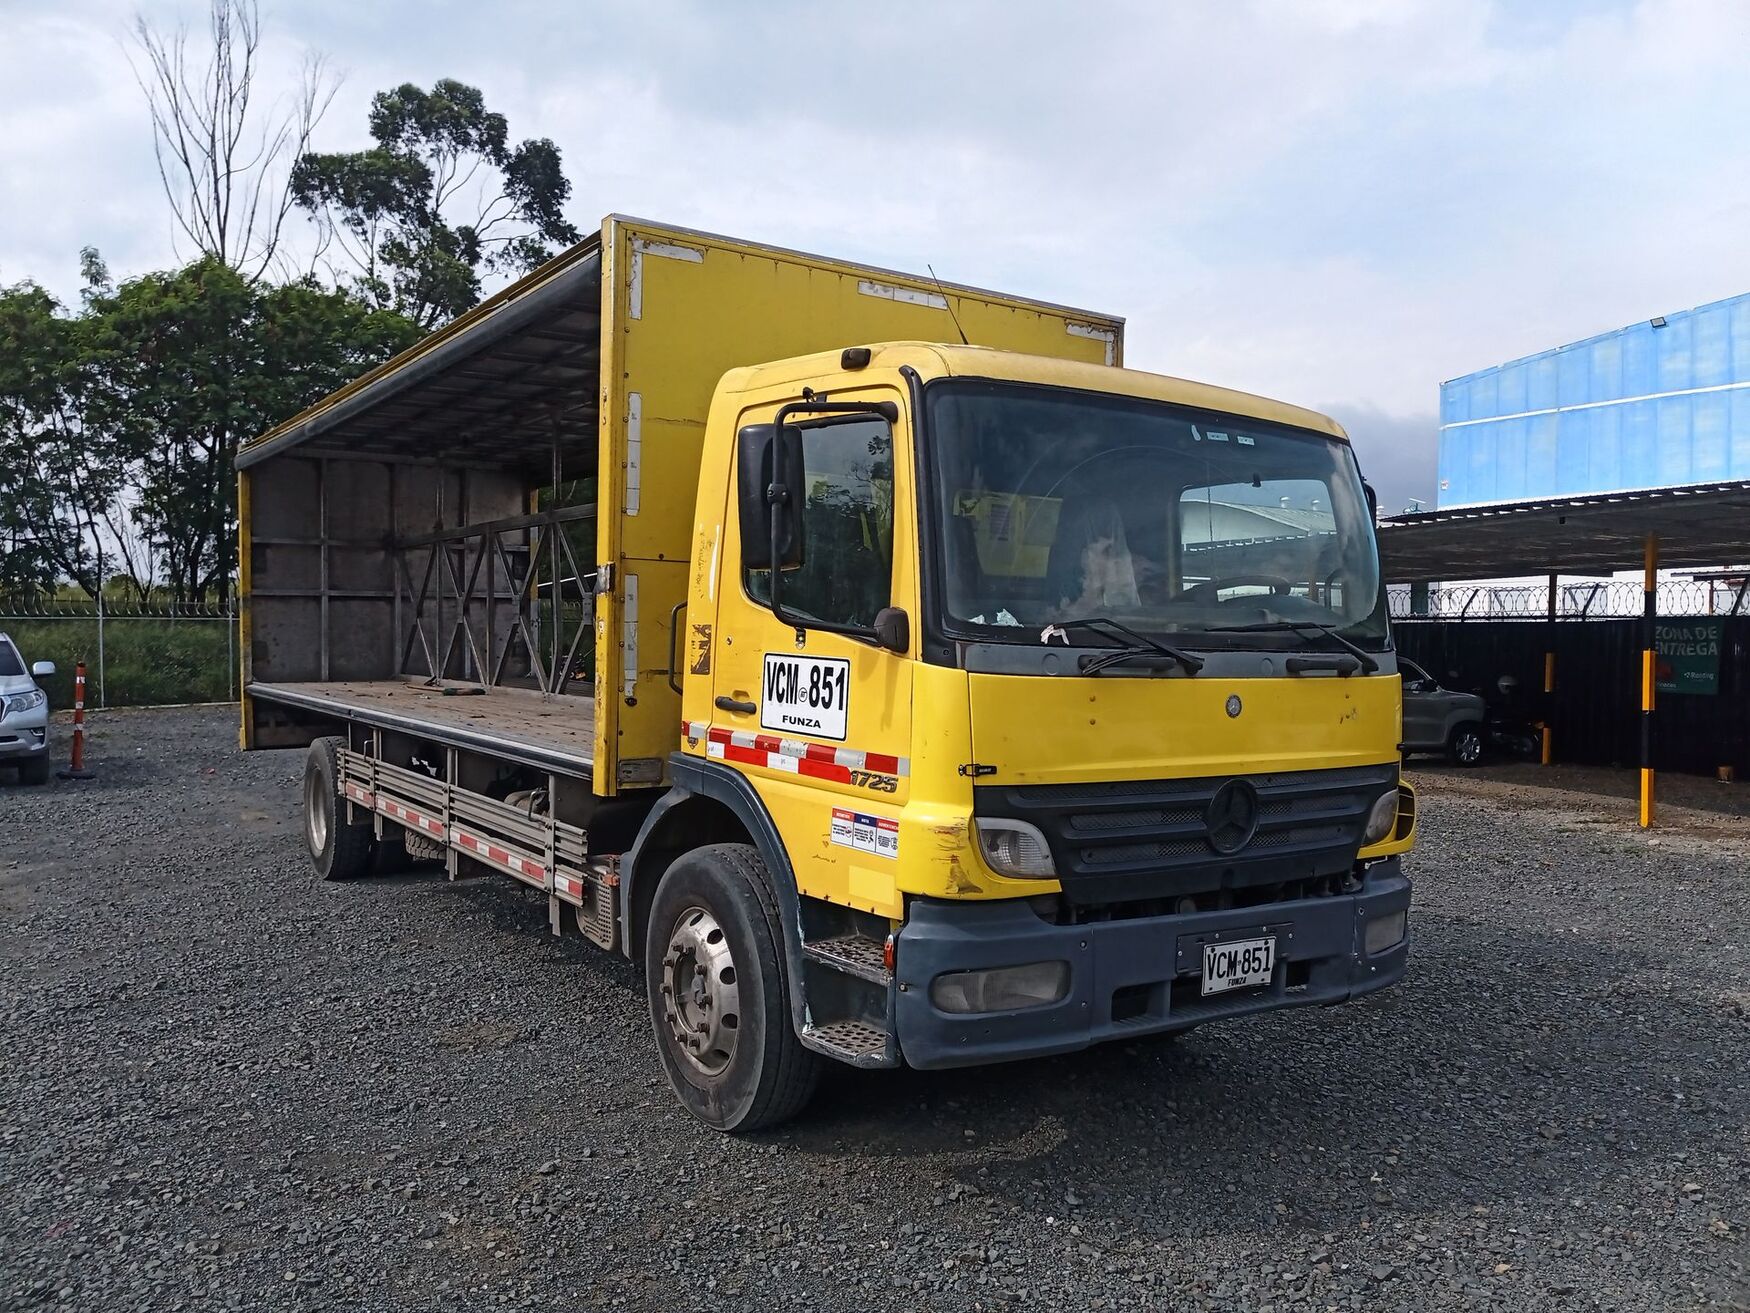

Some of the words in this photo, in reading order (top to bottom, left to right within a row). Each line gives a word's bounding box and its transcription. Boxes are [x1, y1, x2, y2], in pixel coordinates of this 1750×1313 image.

[1655, 626, 1693, 640] ZONA
[1695, 626, 1718, 640] DE
[767, 661, 799, 705] VCM
[808, 664, 846, 711] 851
[782, 715, 821, 728] FUNZA
[850, 770, 899, 793] 1725
[1207, 950, 1238, 981] VCM
[1241, 946, 1271, 975] 851
[1227, 976, 1247, 987] FUNZA
